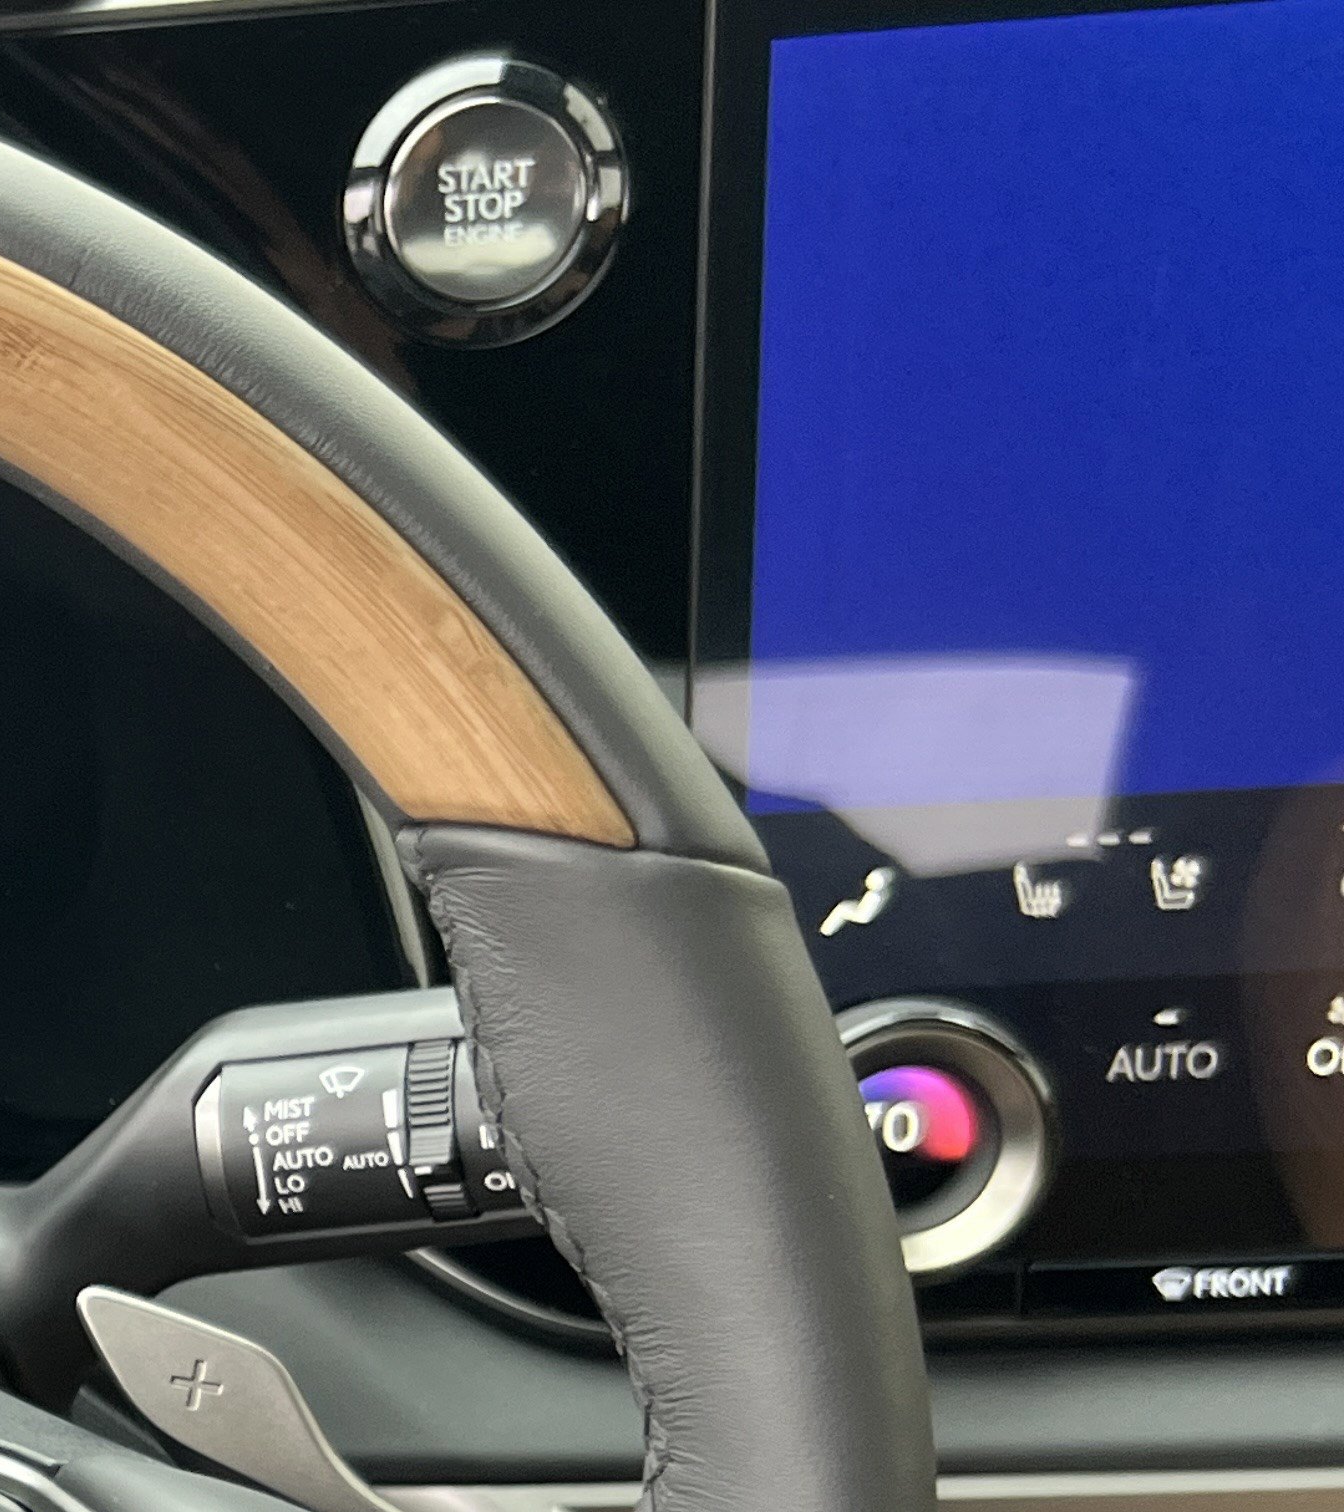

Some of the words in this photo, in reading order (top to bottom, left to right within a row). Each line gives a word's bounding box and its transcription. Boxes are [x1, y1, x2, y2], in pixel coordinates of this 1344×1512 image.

[437, 158, 536, 194] START
[444, 191, 526, 222] STOP
[444, 223, 523, 246] ENGINE
[1107, 1040, 1218, 1082] AUTO
[263, 1097, 316, 1122] MIST
[265, 1122, 311, 1146] OFF
[273, 1146, 335, 1172] AUTO
[342, 1151, 390, 1171] AUTO
[274, 1174, 306, 1196] LO
[278, 1197, 304, 1214] HI
[1192, 1265, 1293, 1300] FRONT
